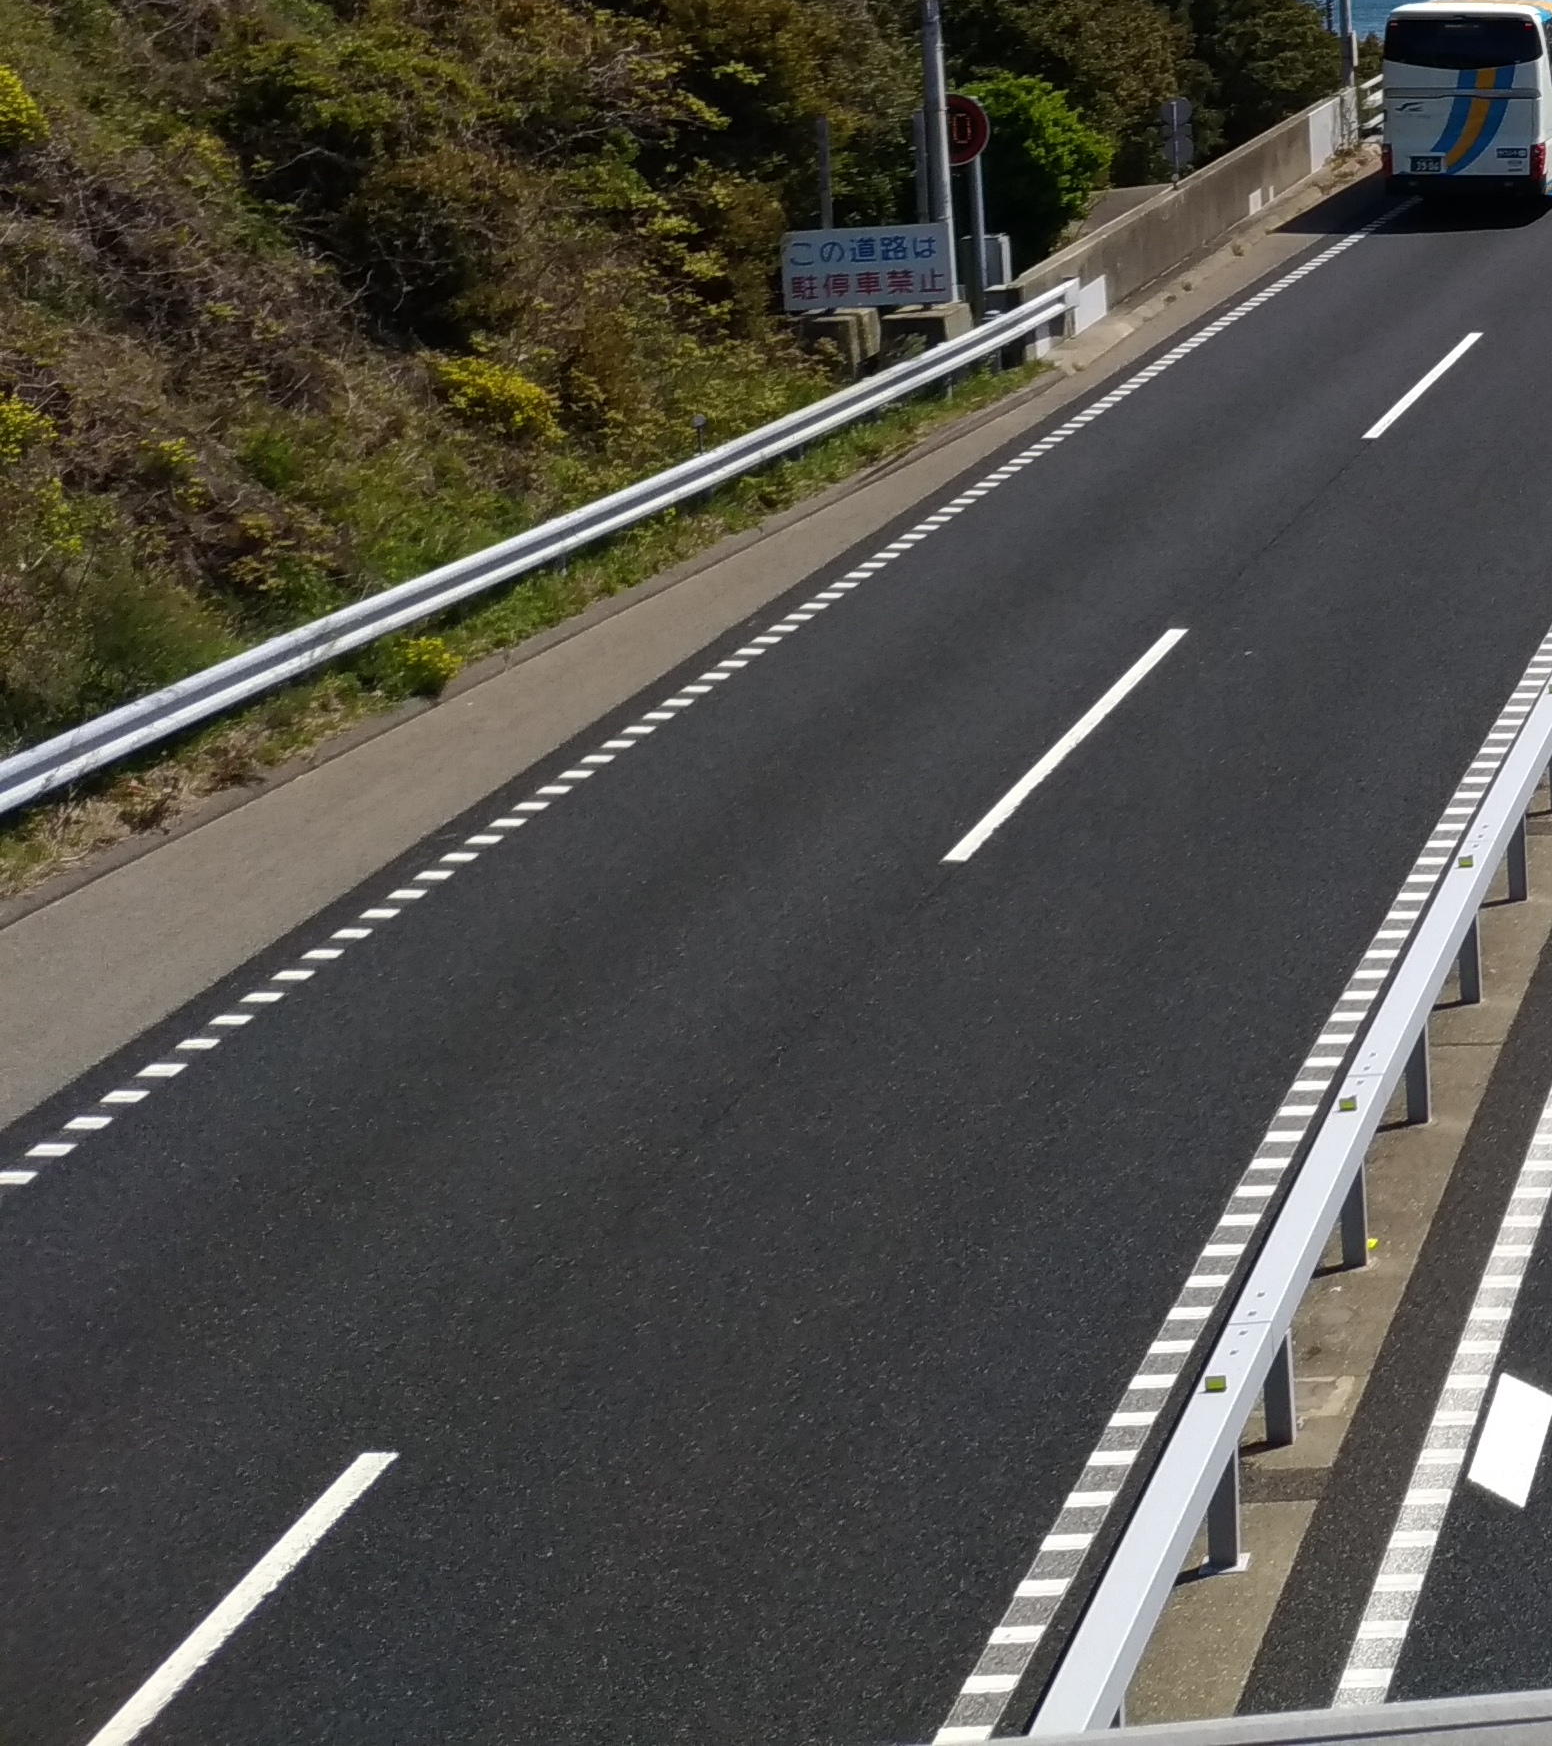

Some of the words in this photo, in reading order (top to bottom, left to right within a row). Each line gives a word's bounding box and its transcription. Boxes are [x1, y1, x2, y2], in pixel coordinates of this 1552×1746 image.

[947, 113, 972, 144] 0
[789, 234, 937, 266] この道路は
[790, 267, 947, 300] 駐停車禁止
